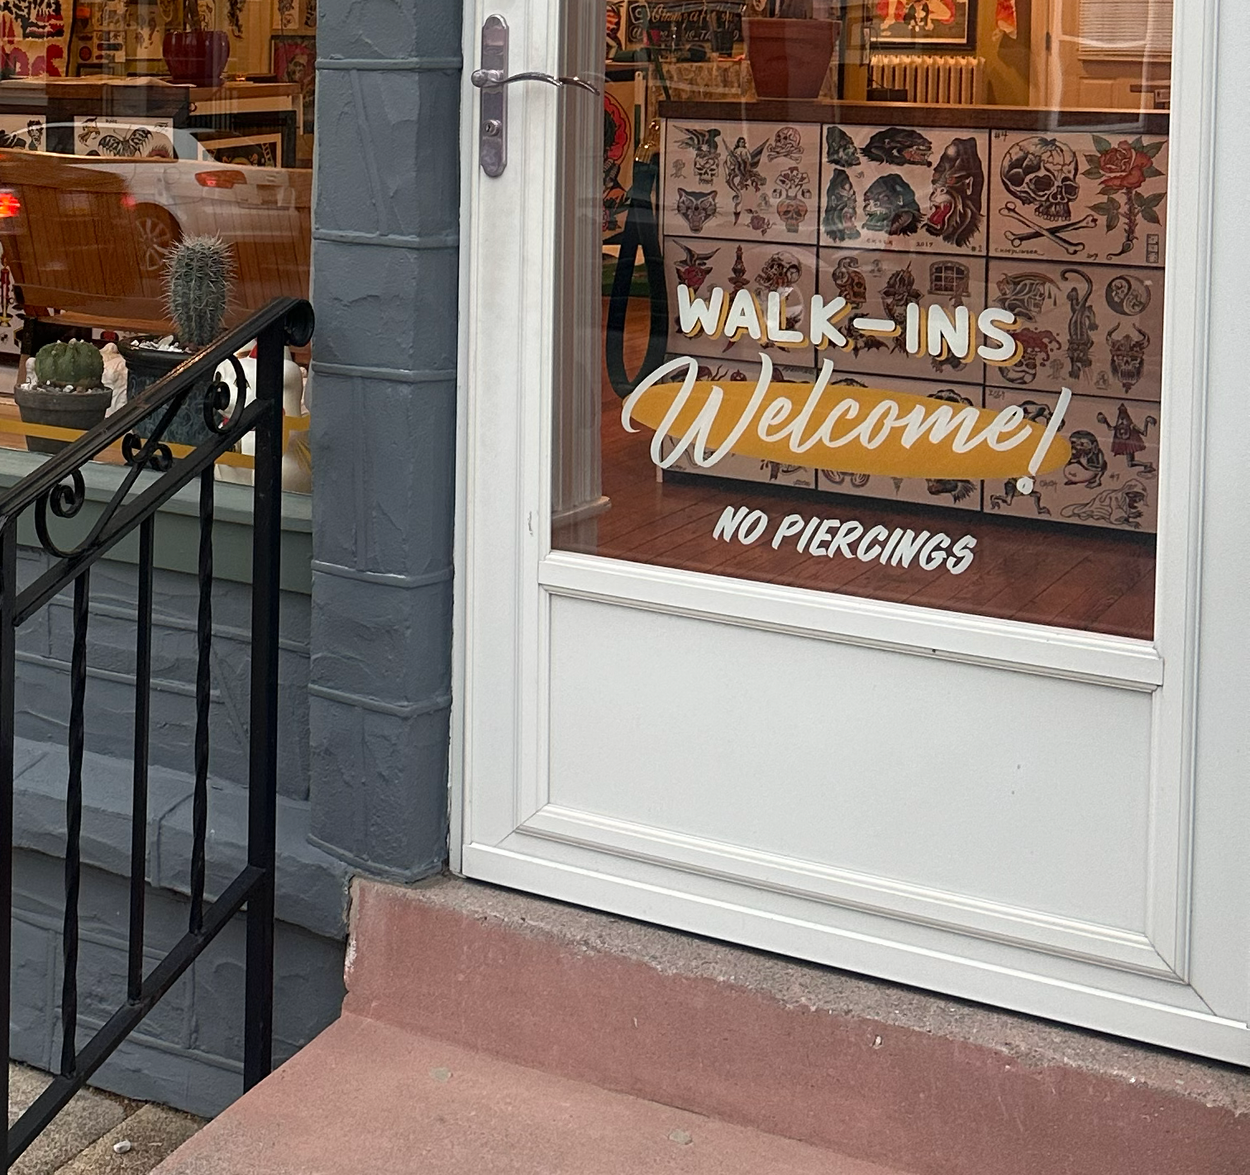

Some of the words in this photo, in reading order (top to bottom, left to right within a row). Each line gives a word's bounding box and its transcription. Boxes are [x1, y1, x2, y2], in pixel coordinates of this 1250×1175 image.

[676, 283, 1021, 363] WALK-INS
[621, 352, 1072, 495] Welcome!
[712, 503, 768, 543] NO
[772, 512, 978, 575] PIERCINGS
